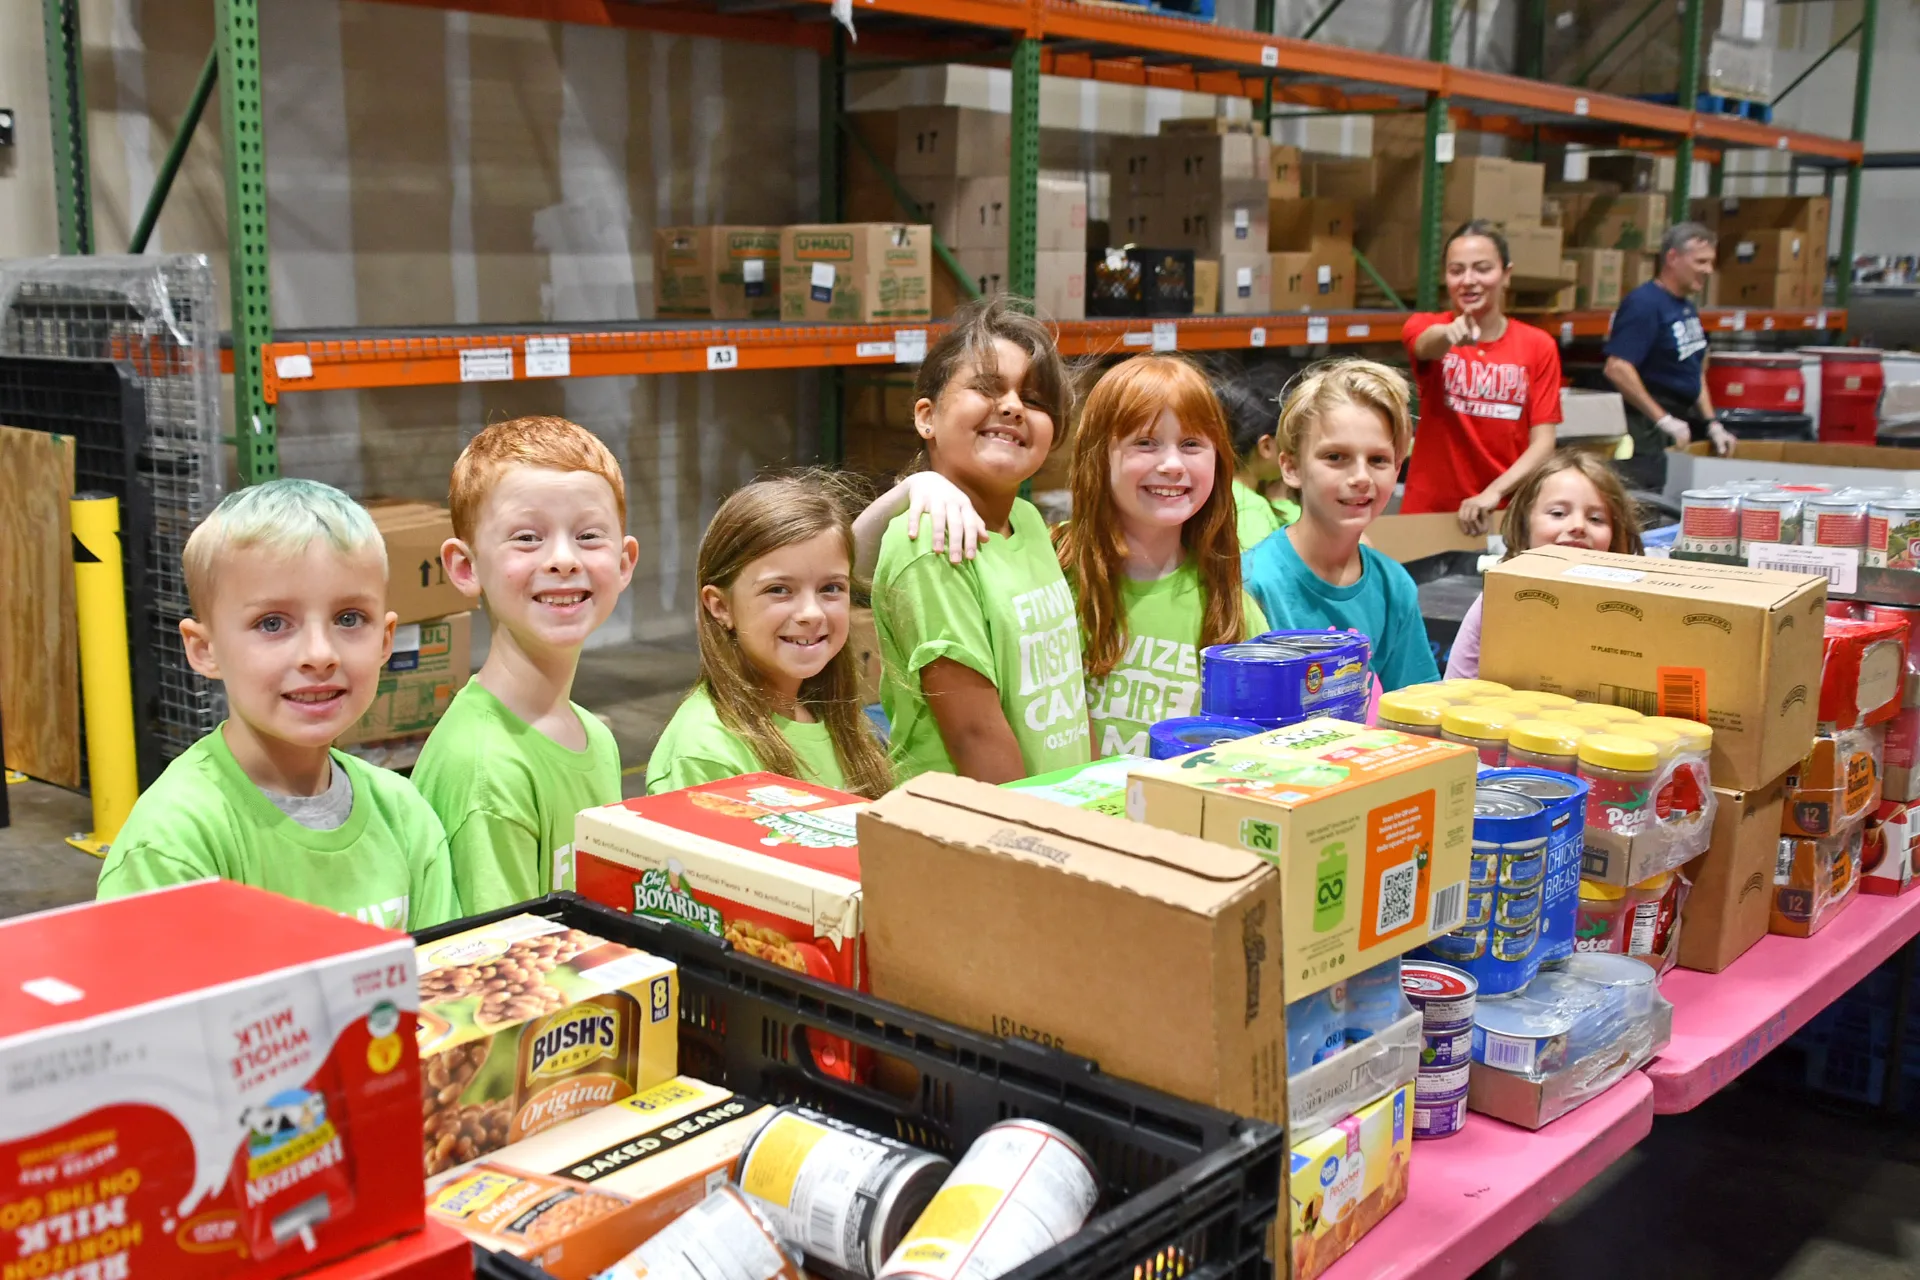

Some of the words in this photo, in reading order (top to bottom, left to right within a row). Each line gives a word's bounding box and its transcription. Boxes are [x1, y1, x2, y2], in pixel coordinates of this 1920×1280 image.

[1647, 579, 1685, 590] SIDE
[1803, 807, 1820, 823] 12
[1253, 823, 1272, 849] 24
[601, 840, 625, 854] Artificial
[625, 848, 662, 865] Preservatives
[1547, 834, 1584, 874] CHICKE
[641, 871, 667, 890] Chef
[696, 872, 720, 884] Artificial
[720, 879, 741, 892] Flavors
[634, 885, 722, 937] BOYARDEE
[764, 893, 790, 907] Artificial
[1787, 895, 1803, 913] 12
[385, 962, 408, 988] 12
[653, 980, 667, 1009] 8
[234, 1006, 294, 1047] MILK
[654, 1008, 667, 1020] PACK
[229, 1028, 311, 1080] WHOLE
[532, 1016, 614, 1072] BUSH'S
[551, 1049, 591, 1068] BEST
[521, 1080, 616, 1131] Original
[1394, 1103, 1403, 1120] 12
[572, 1138, 661, 1179] BAKED
[660, 1102, 745, 1140] BEANS
[99, 1166, 142, 1200] ON
[245, 1135, 344, 1207] HORIZON
[47, 1181, 95, 1212] THE
[477, 1182, 541, 1224] Original
[0, 1196, 43, 1231] GO
[17, 1194, 127, 1257] MILK
[2, 1221, 143, 1280] HORIZON
